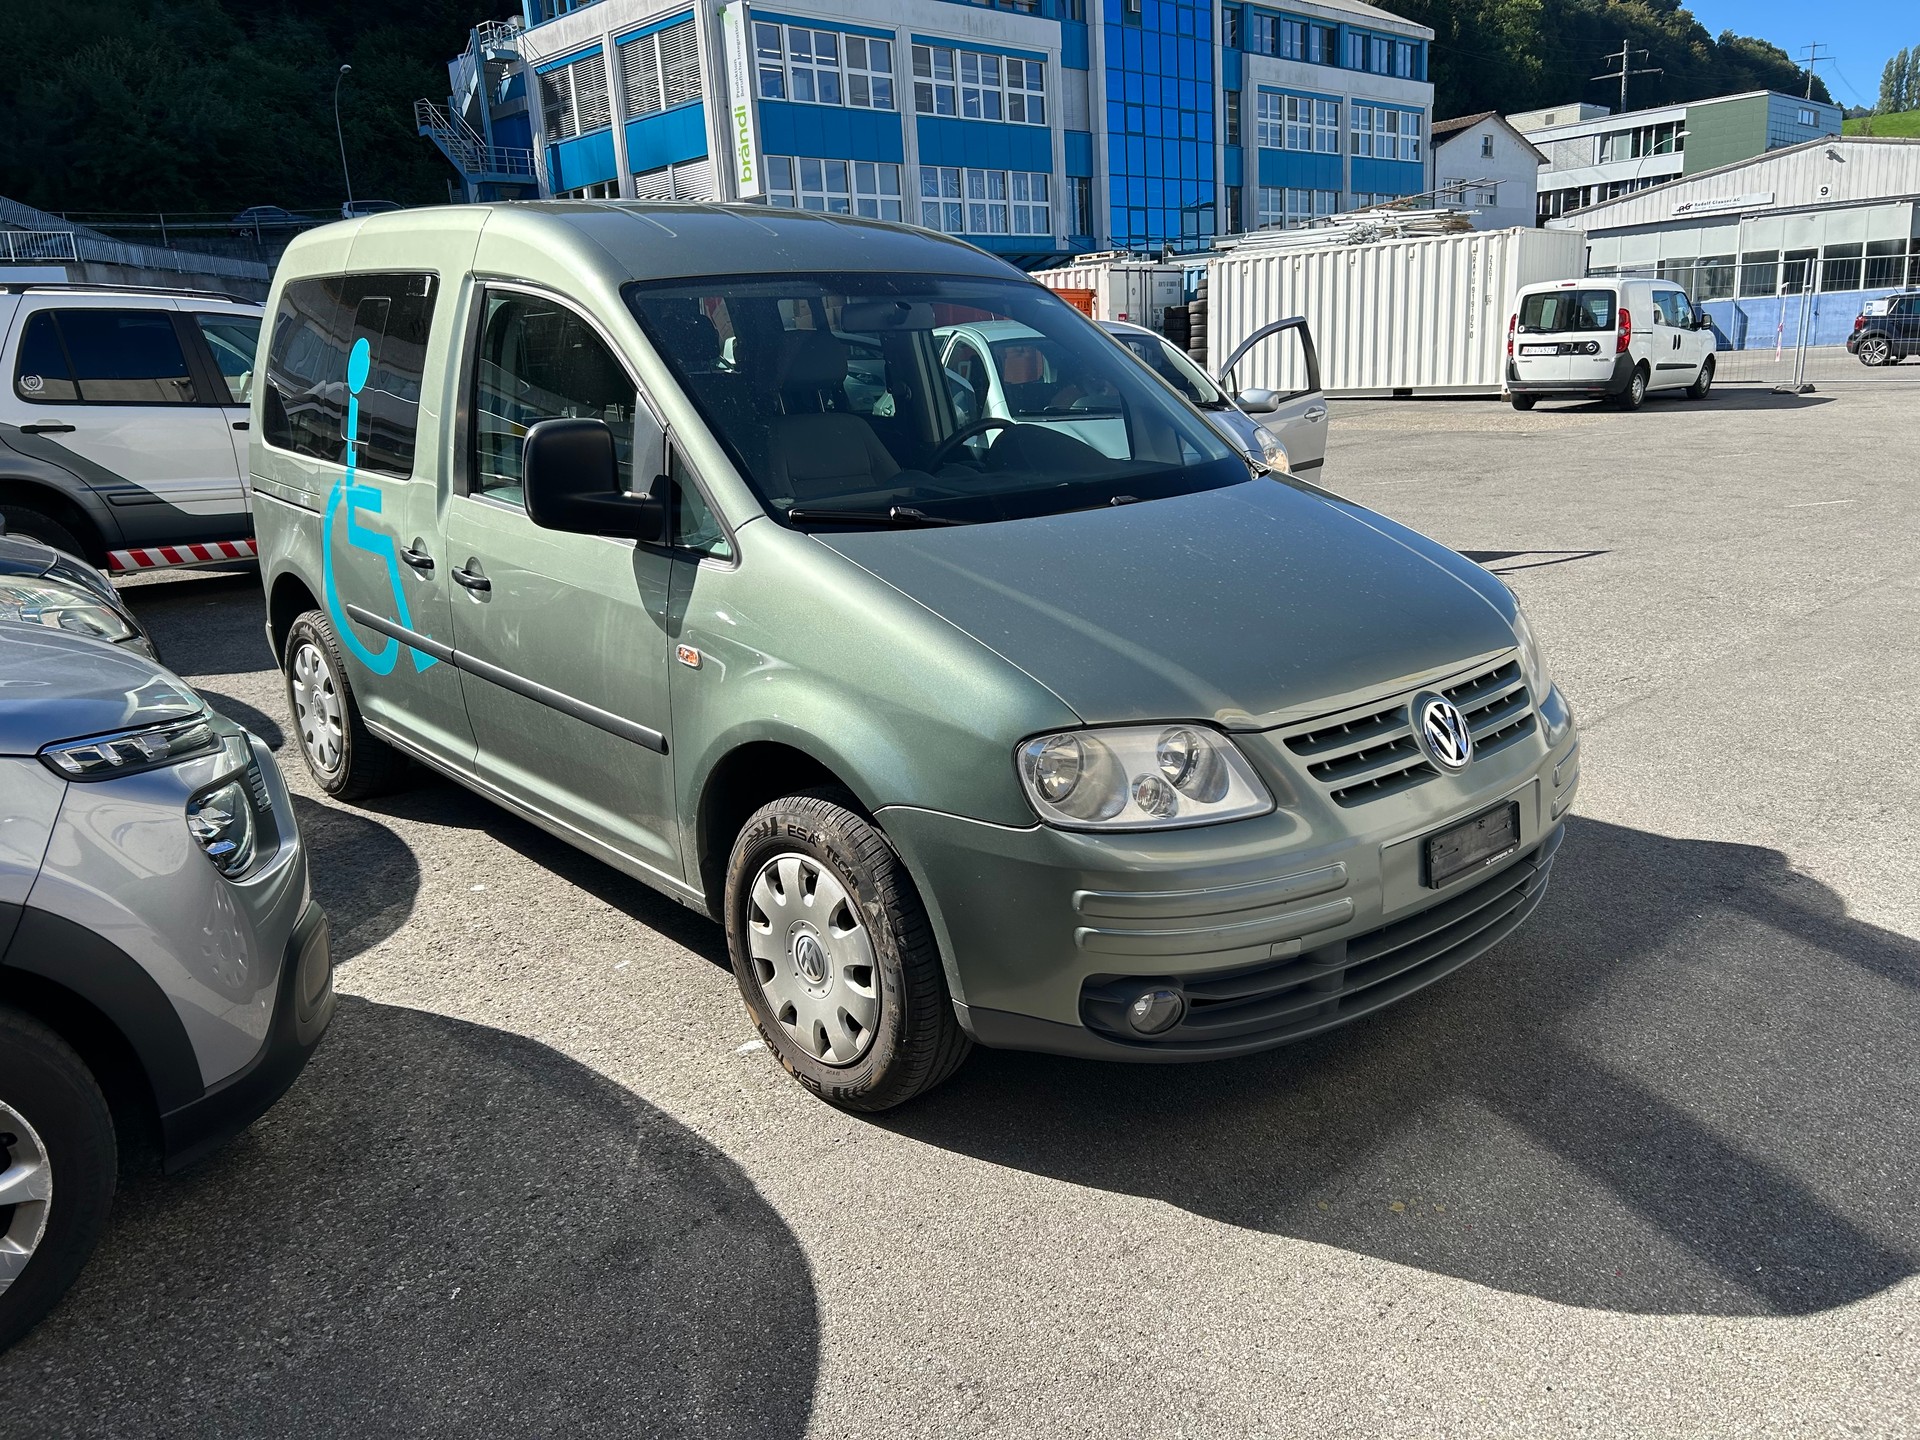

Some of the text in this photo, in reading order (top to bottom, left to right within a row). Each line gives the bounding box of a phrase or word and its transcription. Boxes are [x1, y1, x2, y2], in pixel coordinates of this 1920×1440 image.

[735, 105, 752, 183] brändi
[1820, 186, 1829, 196] 9
[1423, 701, 1471, 767] VW
[826, 845, 859, 890] TECAR
